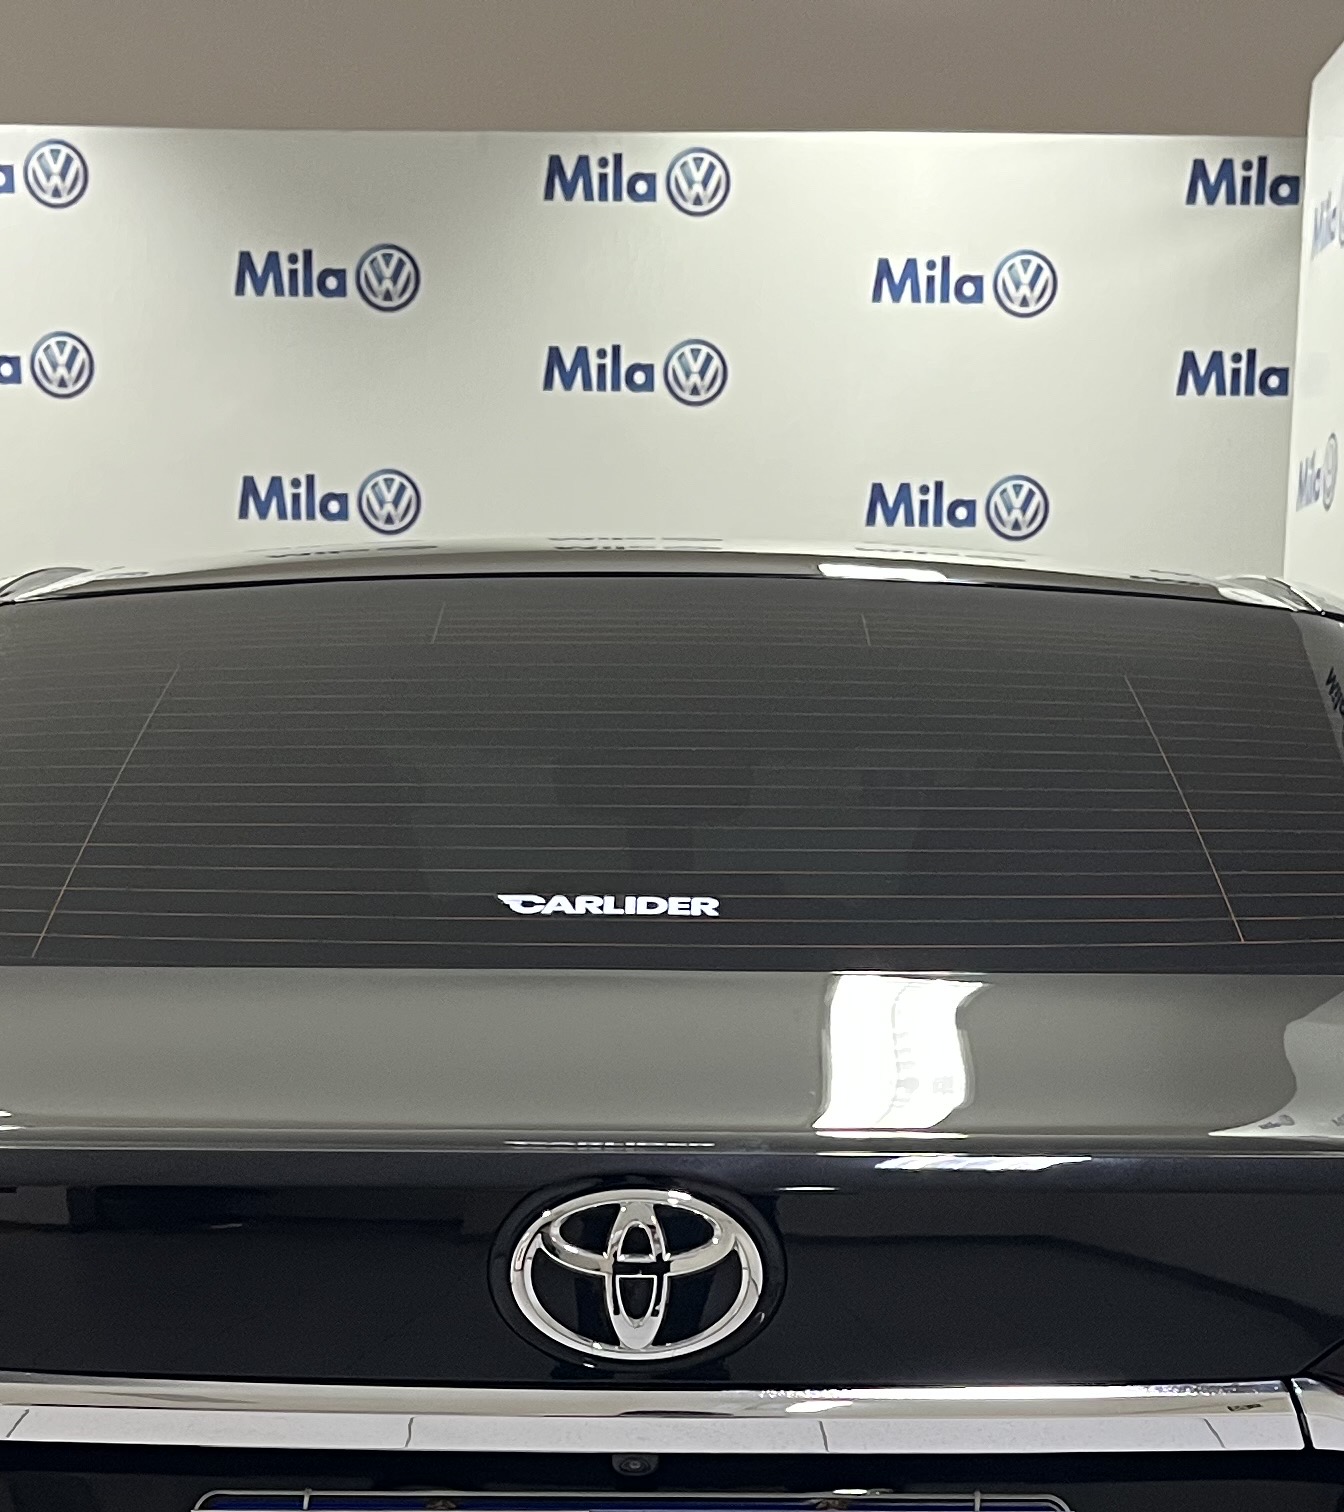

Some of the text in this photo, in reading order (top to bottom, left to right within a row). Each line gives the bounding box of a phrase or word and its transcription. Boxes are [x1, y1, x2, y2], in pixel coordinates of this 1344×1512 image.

[543, 153, 657, 203] Mila
[1185, 156, 1301, 206] Mila
[235, 249, 347, 298] Mila
[872, 256, 984, 304] Mila
[542, 344, 654, 392] Mila
[1176, 349, 1289, 397] Mila
[238, 475, 349, 521] Mila
[865, 482, 976, 528] Mila
[497, 894, 720, 917] CARLIDER
